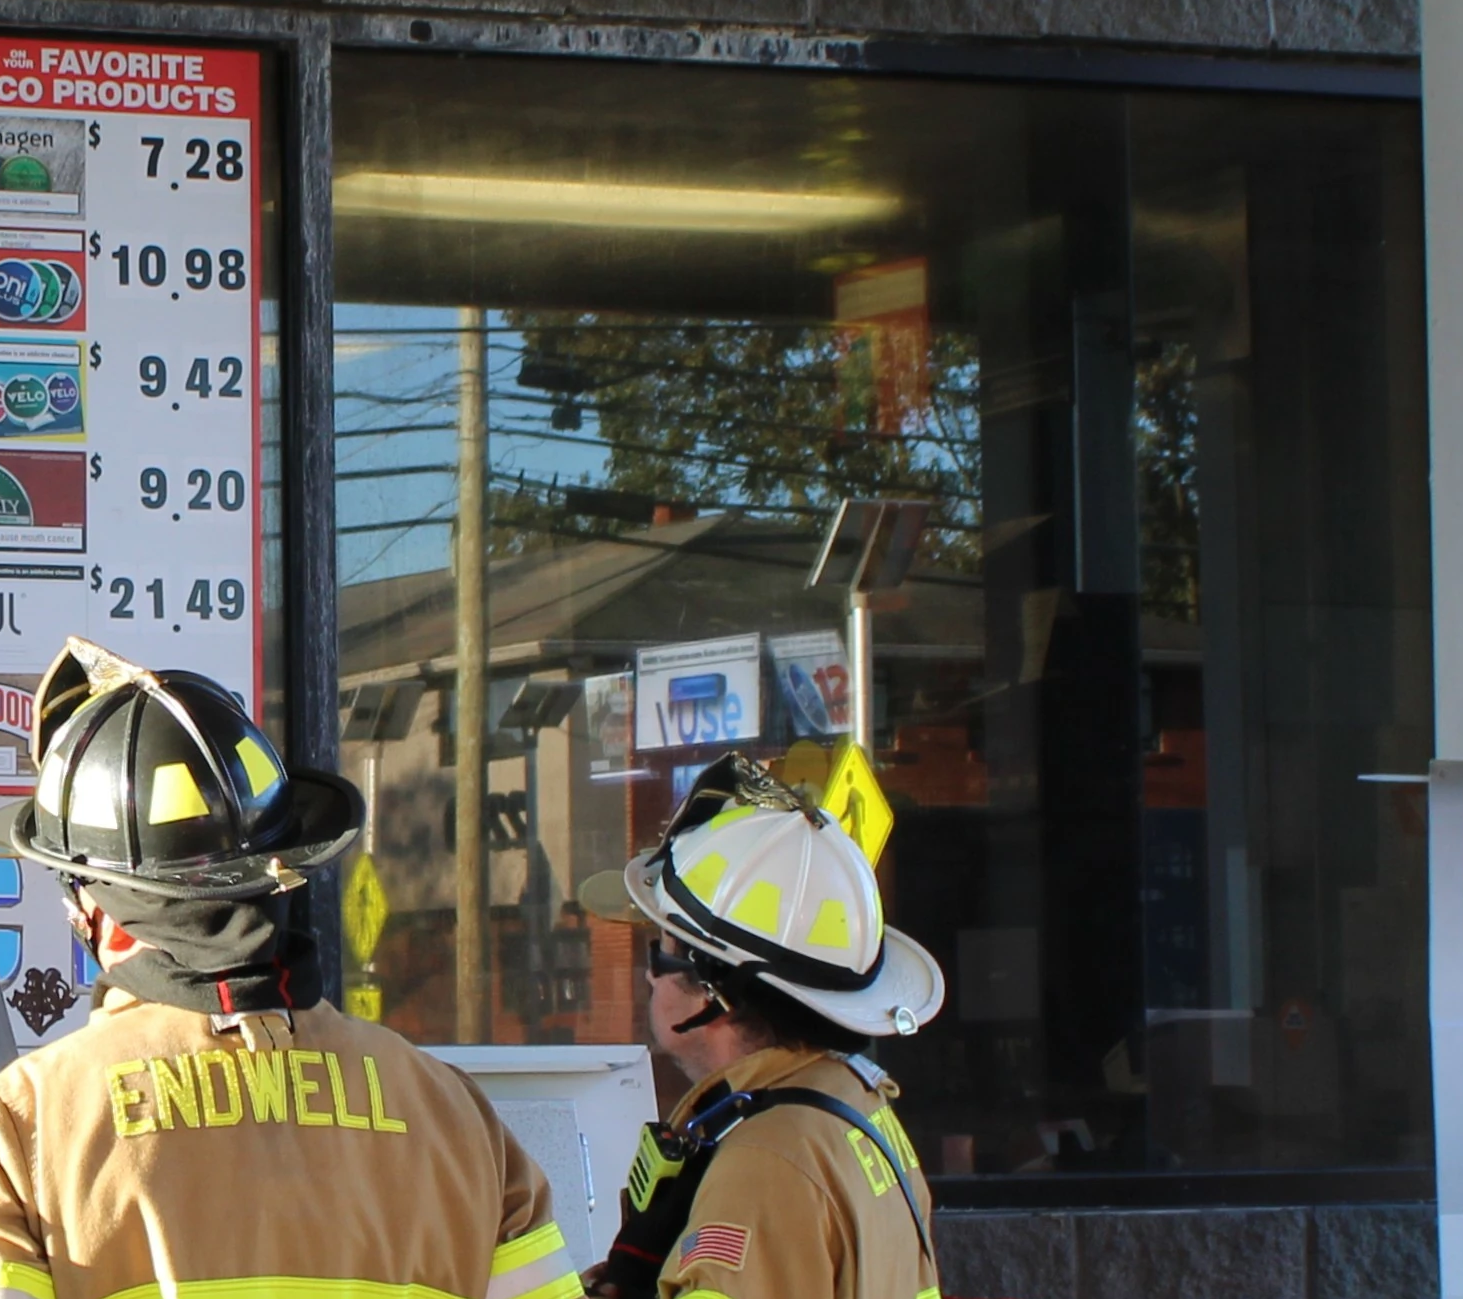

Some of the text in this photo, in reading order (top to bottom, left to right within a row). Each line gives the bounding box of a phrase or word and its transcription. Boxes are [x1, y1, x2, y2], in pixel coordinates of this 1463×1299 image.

[3, 58, 34, 69] YOUR
[41, 49, 204, 81] FAVORITE
[52, 79, 236, 113] PRODUCTS
[88, 120, 244, 191] $7.28
[88, 230, 246, 301] $10.98
[7, 391, 45, 403] VELO
[89, 341, 244, 411] $9.42
[90, 453, 245, 523] $9.20
[20, 533, 46, 543] mouth
[90, 563, 246, 633] $21.49
[110, 1048, 408, 1137] ENDWELL
